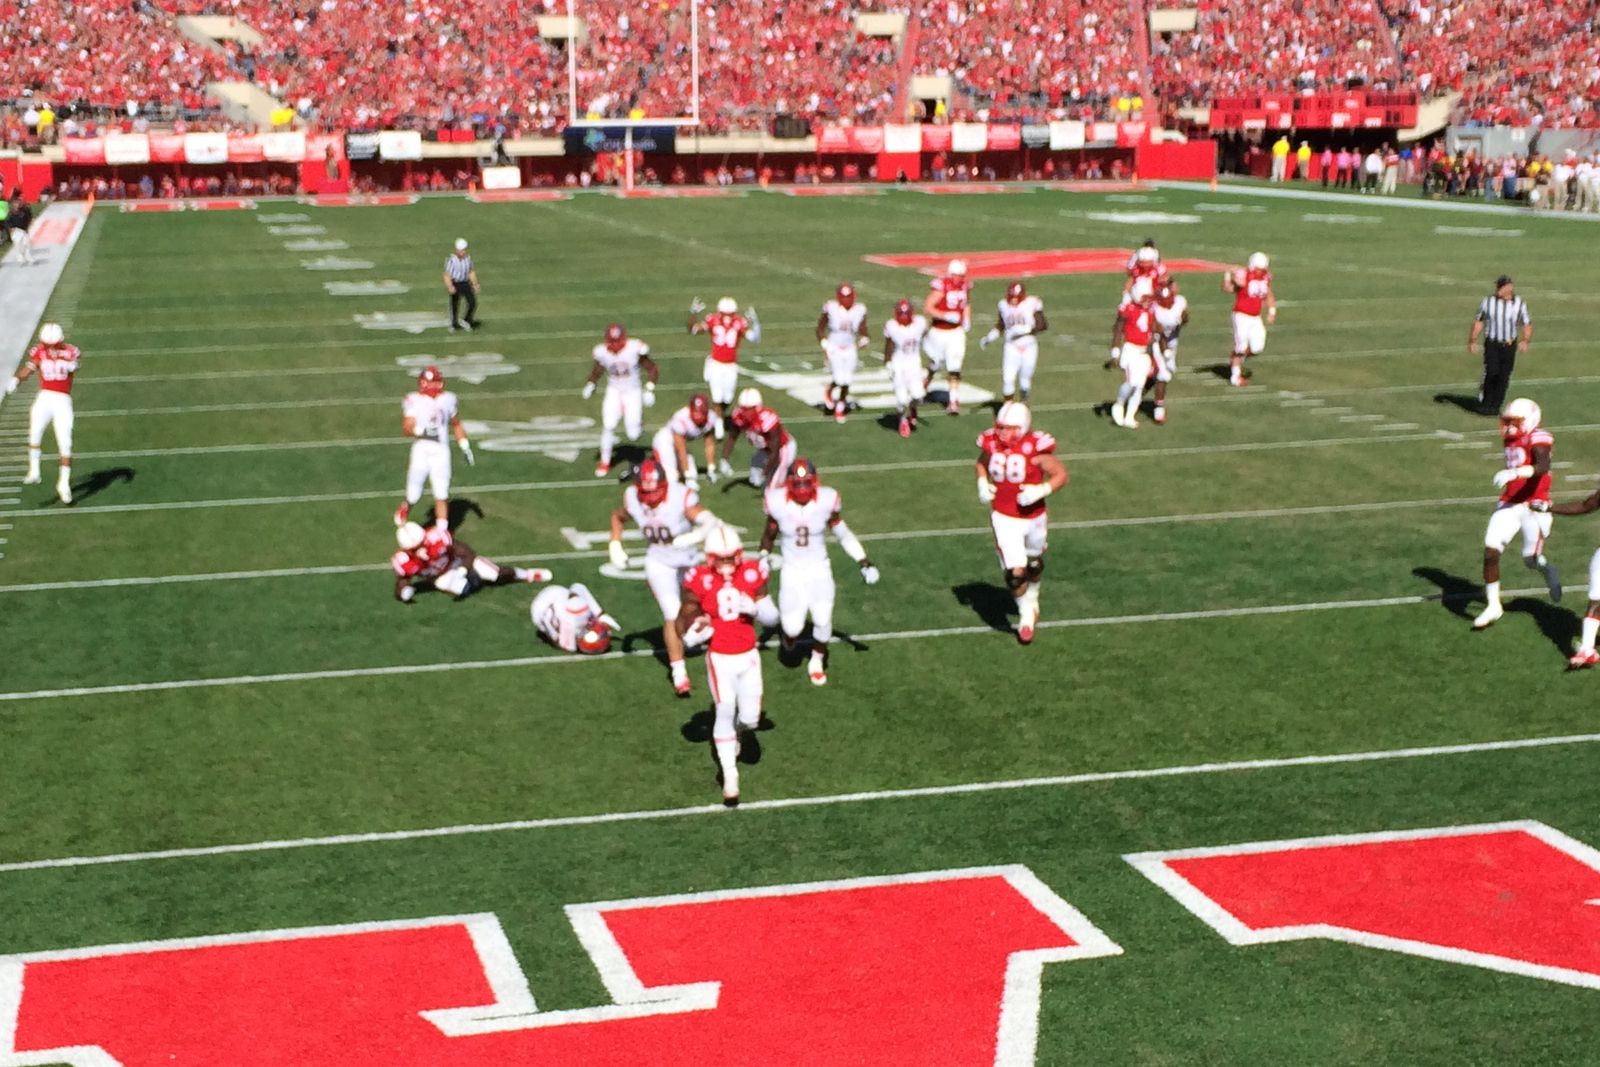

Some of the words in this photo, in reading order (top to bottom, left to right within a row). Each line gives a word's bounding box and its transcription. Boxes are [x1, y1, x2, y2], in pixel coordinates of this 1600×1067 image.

[1136, 311, 1149, 333] 4
[988, 452, 1027, 484] 68
[794, 525, 810, 548] 3
[716, 586, 742, 621] 8
